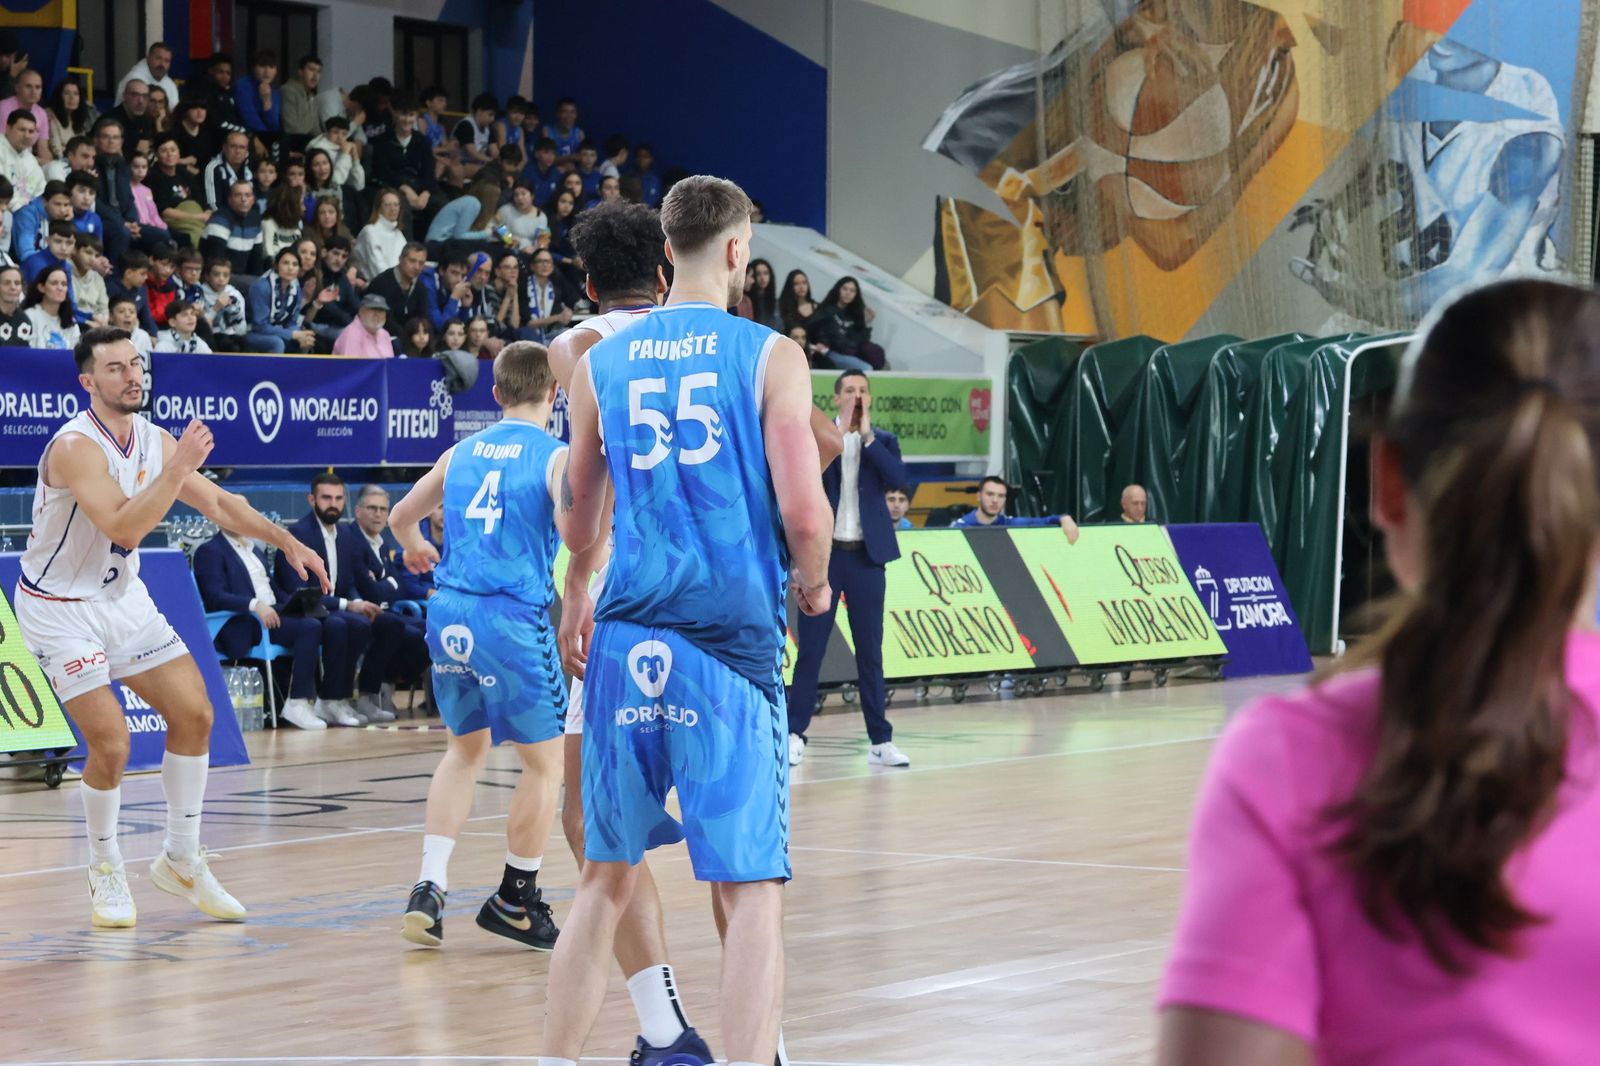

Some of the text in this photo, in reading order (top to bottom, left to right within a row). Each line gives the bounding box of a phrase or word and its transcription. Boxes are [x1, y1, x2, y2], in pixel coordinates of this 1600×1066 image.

[153, 395, 239, 421] ORALEJO
[290, 397, 379, 422] MORALEJO
[388, 408, 439, 438] FITECU
[628, 372, 723, 470] 55
[472, 441, 523, 459] ROUND
[464, 470, 503, 535] 4
[1097, 595, 1209, 646] MORANO
[1230, 602, 1292, 629] ZAMORA
[889, 606, 1014, 659] MORANO
